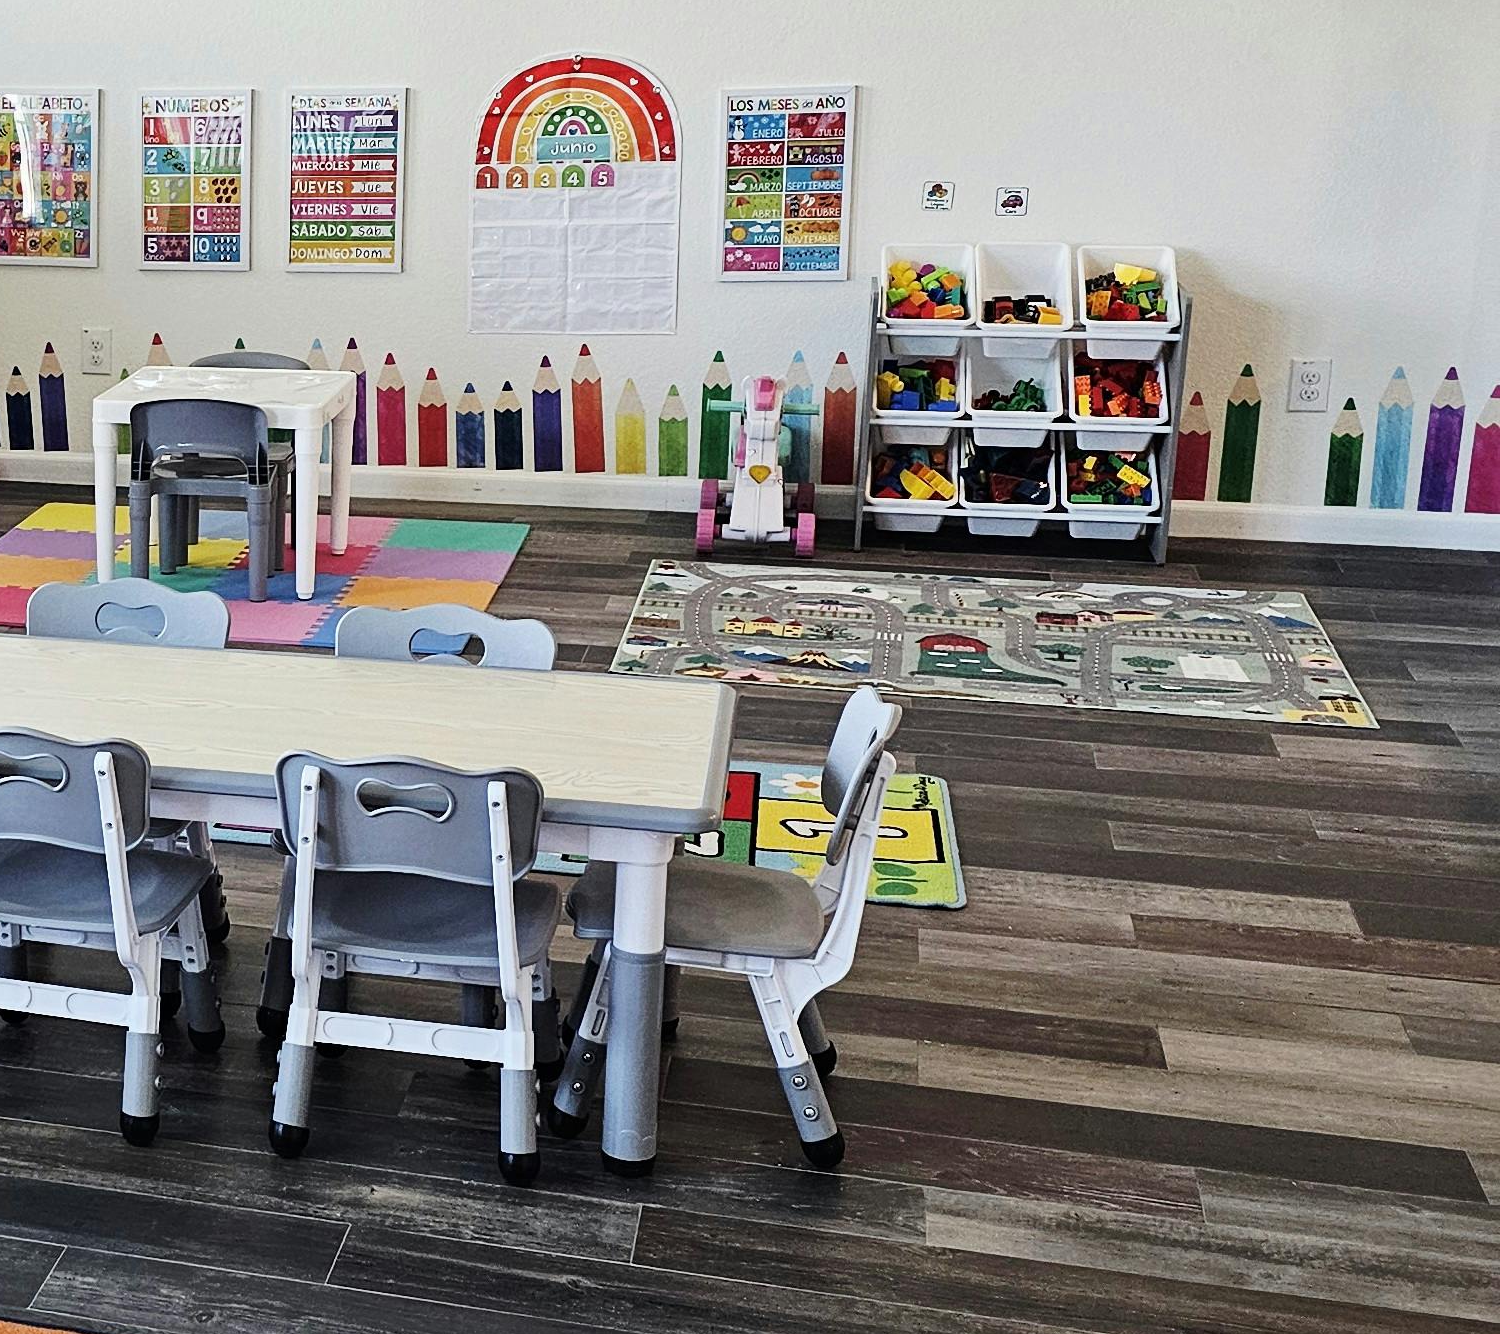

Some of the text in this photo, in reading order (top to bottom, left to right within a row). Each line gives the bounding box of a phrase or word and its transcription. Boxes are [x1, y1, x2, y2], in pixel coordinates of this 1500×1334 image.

[21, 97, 83, 110] ALFABETO
[344, 97, 391, 107] SEMANA
[730, 100, 754, 112] LOS
[758, 98, 799, 111] MESES
[816, 95, 845, 109] AÑO
[150, 119, 155, 135] 1
[196, 118, 206, 135] 6
[293, 114, 340, 129] LUNES
[752, 129, 783, 138] ENERO
[818, 128, 844, 137] JULIO
[292, 136, 351, 150] MARTES
[550, 141, 597, 156] junio
[146, 149, 157, 165] 2
[200, 149, 210, 165] 7
[741, 156, 783, 166] FEBRERO
[805, 154, 843, 164] AGOSTO
[484, 171, 608, 187] 1 2 3 4 5
[150, 179, 160, 195] 3
[199, 178, 209, 194] 8
[292, 179, 344, 194] JUEVES
[749, 183, 782, 192] MARZO
[786, 181, 842, 191] SEPTIEMBRE
[147, 208, 158, 224] 4
[197, 208, 208, 224] 9
[291, 203, 347, 216] VIERNES
[752, 209, 781, 218] ABRIL
[799, 208, 840, 217] OCTUBRE
[147, 238, 157, 253] 5
[195, 237, 209, 253] 10
[754, 235, 780, 244] MAYO
[785, 235, 839, 244] NOVIEMBRE
[291, 248, 350, 260] DOMINGO
[750, 261, 779, 270] JUNIO
[789, 261, 838, 270] DICIEMBRE
